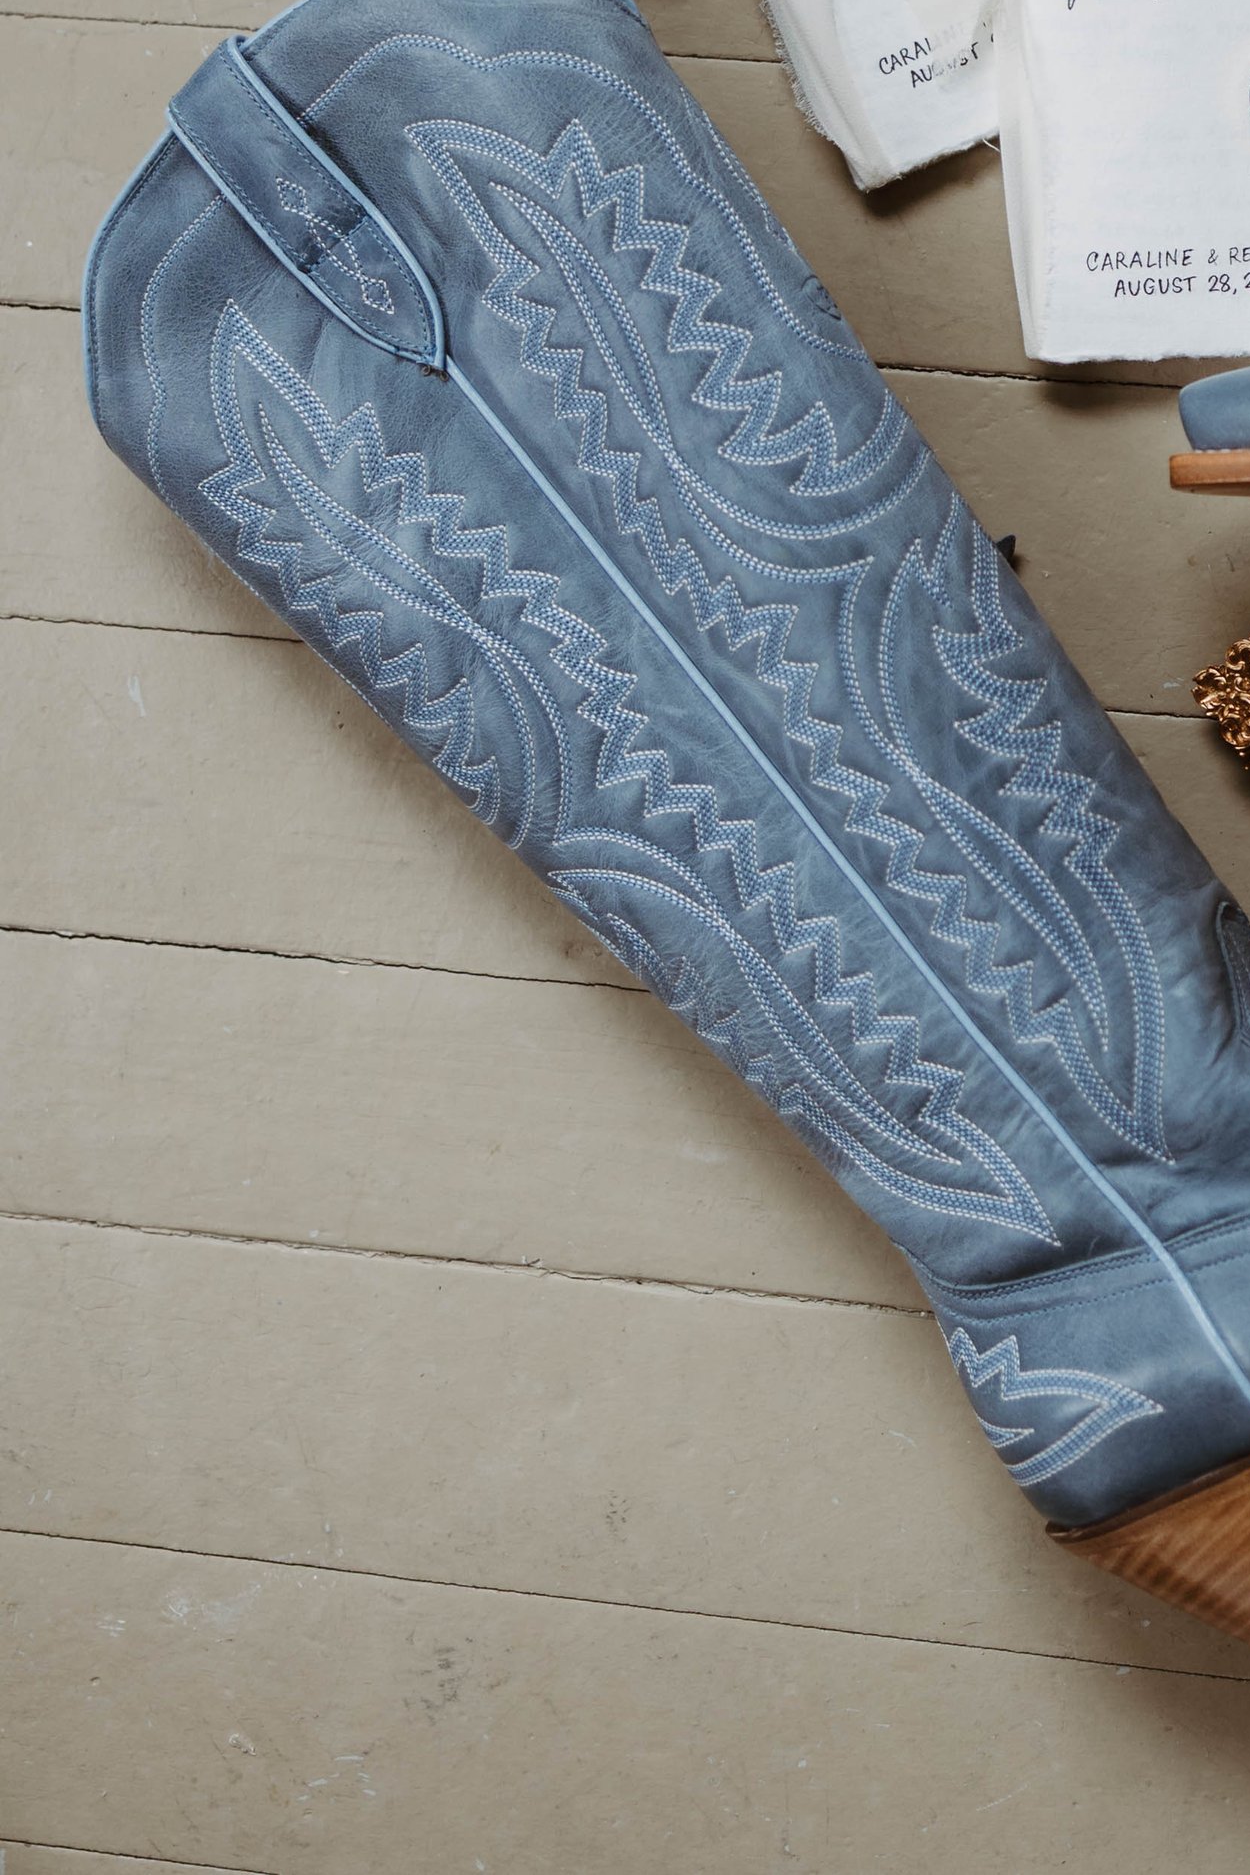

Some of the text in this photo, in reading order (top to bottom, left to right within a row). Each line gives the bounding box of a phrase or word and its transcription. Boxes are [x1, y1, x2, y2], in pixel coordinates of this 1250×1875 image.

[1086, 248, 1195, 272] CARALINE
[1207, 248, 1219, 266] &
[1114, 276, 1197, 298] AUGUST
[1207, 273, 1238, 295] 28,
